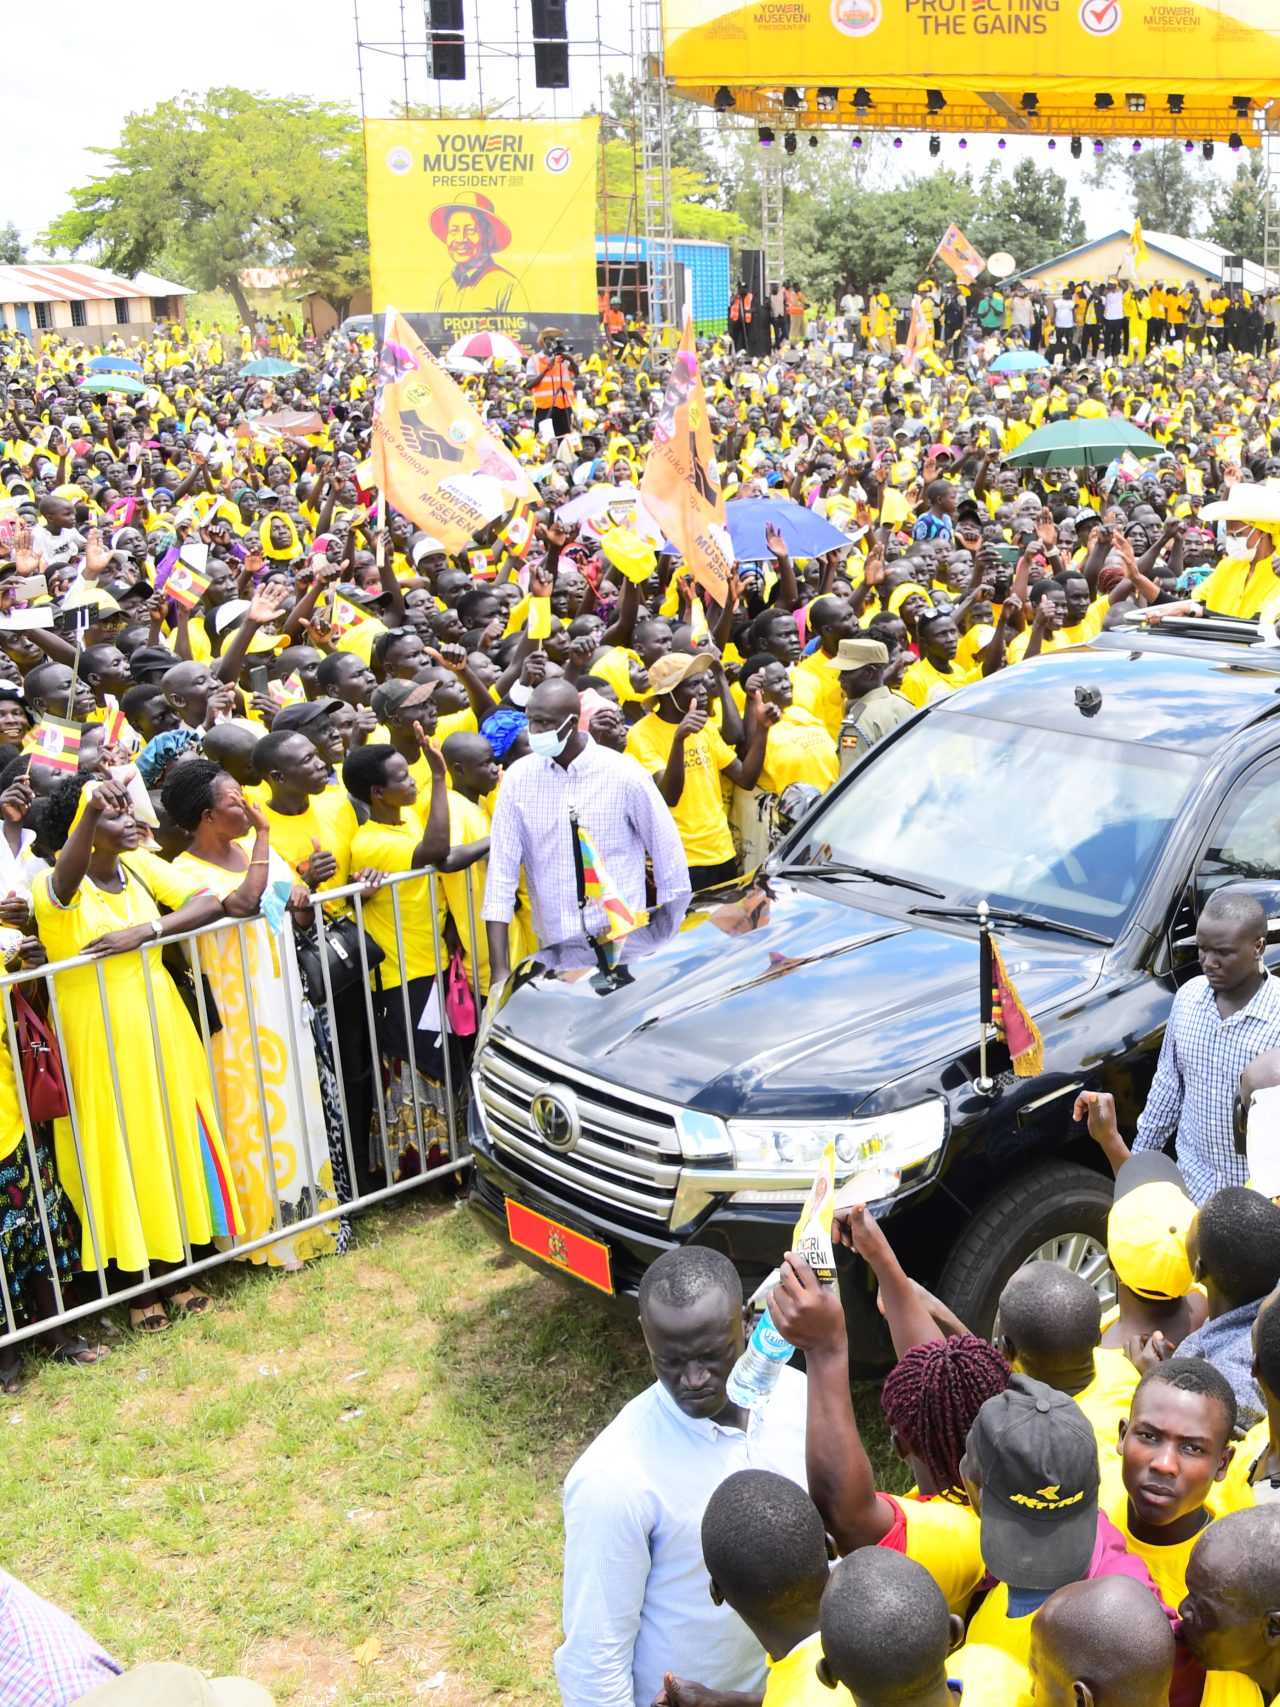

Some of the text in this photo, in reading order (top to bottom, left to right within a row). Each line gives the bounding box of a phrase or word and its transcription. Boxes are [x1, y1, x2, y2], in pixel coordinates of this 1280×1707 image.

[760, 4, 804, 13] YOWERI
[905, 0, 1060, 12] PROTECTING
[1150, 6, 1194, 16] YOWERI
[753, 14, 810, 23] MUSEVENI
[918, 14, 1047, 35] THE GAINS
[1143, 16, 1200, 25] MUSEVENI
[436, 134, 523, 153] YOWERI
[423, 154, 534, 172] MUSEVENI
[432, 175, 507, 187] PRESIDENT
[443, 317, 526, 330] PROTECTING
[395, 444, 430, 476] Pamoja
[664, 447, 685, 476] Tuko
[434, 486, 483, 521] YOWERI
[428, 510, 450, 526] NOW
[706, 562, 726, 582] NOW
